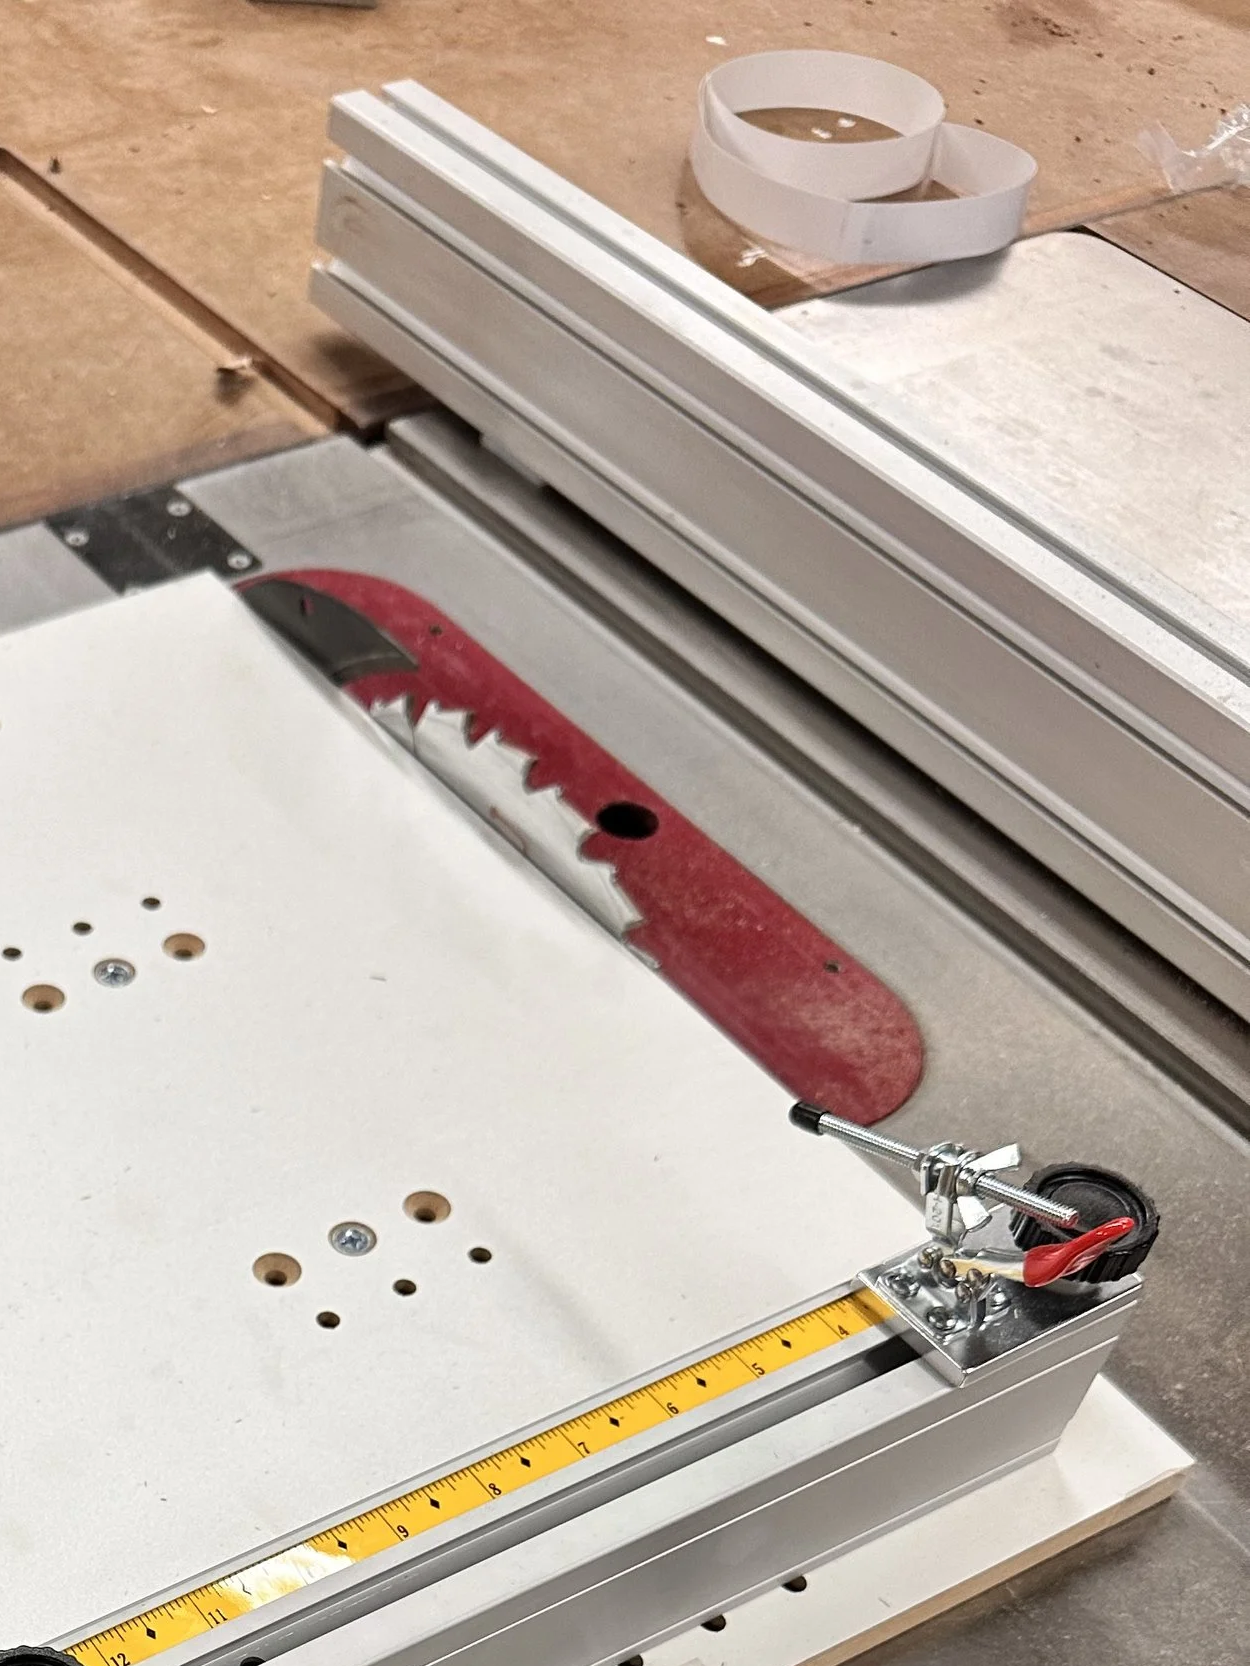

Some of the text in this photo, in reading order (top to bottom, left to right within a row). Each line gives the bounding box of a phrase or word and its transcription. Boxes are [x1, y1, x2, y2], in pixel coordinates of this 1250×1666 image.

[208, 1607, 228, 1625] 11
[396, 1524, 410, 1539] 9
[488, 1482, 502, 1496] 8
[577, 1441, 591, 1455] 7
[666, 1402, 680, 1415] 6
[751, 1362, 766, 1376] 5
[837, 1324, 850, 1337] 4
